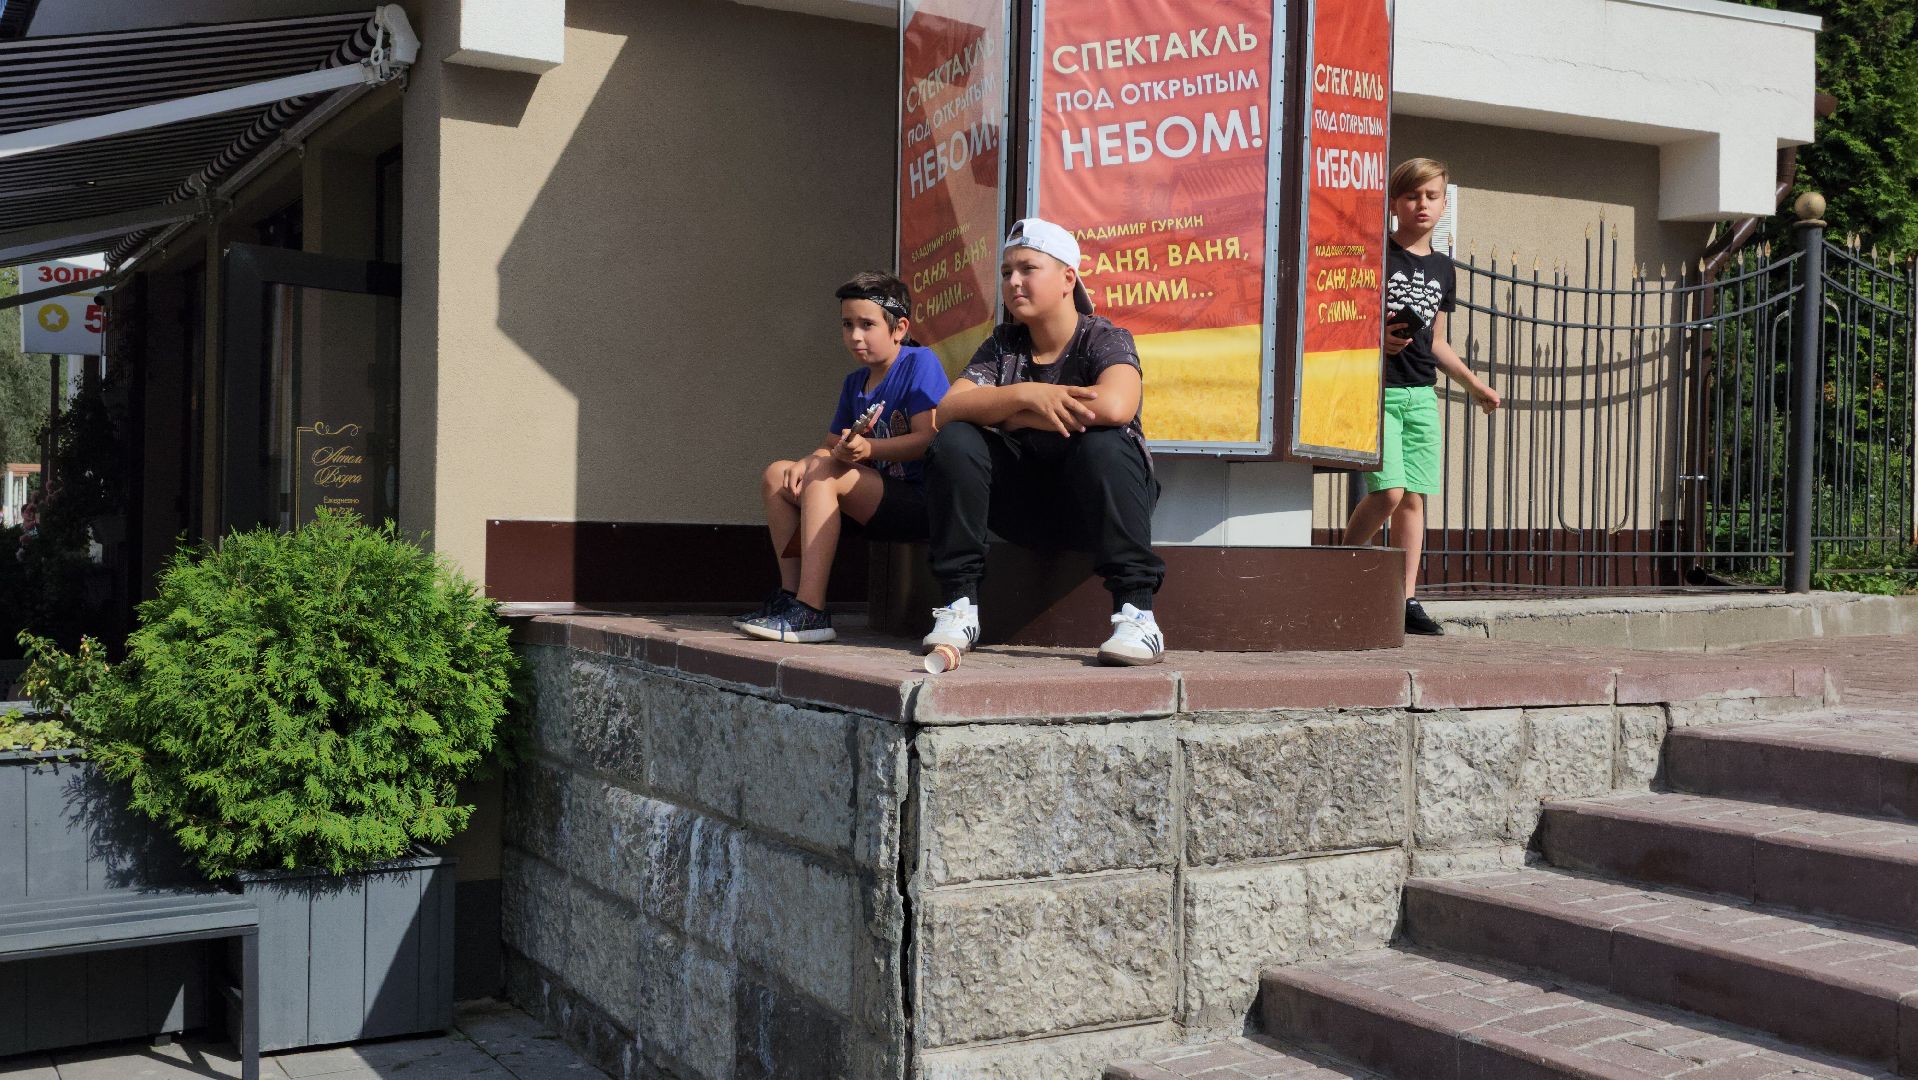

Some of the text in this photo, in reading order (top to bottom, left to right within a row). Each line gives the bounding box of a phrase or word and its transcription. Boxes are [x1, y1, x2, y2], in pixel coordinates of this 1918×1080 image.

[1052, 23, 1258, 75] СПЕКТАКЛЬ
[906, 32, 996, 113] СПЕКТАКЛЬ
[1056, 69, 1260, 113] ПОД ОТКРЫТЫМ
[907, 71, 996, 148] ПОД ОТКРЫТЫМ
[1315, 109, 1338, 134] ПОД
[909, 106, 998, 200] НЕБОМ!
[1061, 105, 1263, 171] НЕБОМ!
[1316, 146, 1384, 191] НЕБОМ!
[1151, 214, 1204, 233] ГУРКИН
[913, 236, 992, 293] САНЯ, ВАНЯ,
[1077, 236, 1249, 278] САНЯ, ВАНЯ,
[1105, 277, 1214, 308] НИМИ...
[1316, 267, 1378, 292] САНЯ, ВАНЯ,
[914, 281, 974, 324] С НИМИ...
